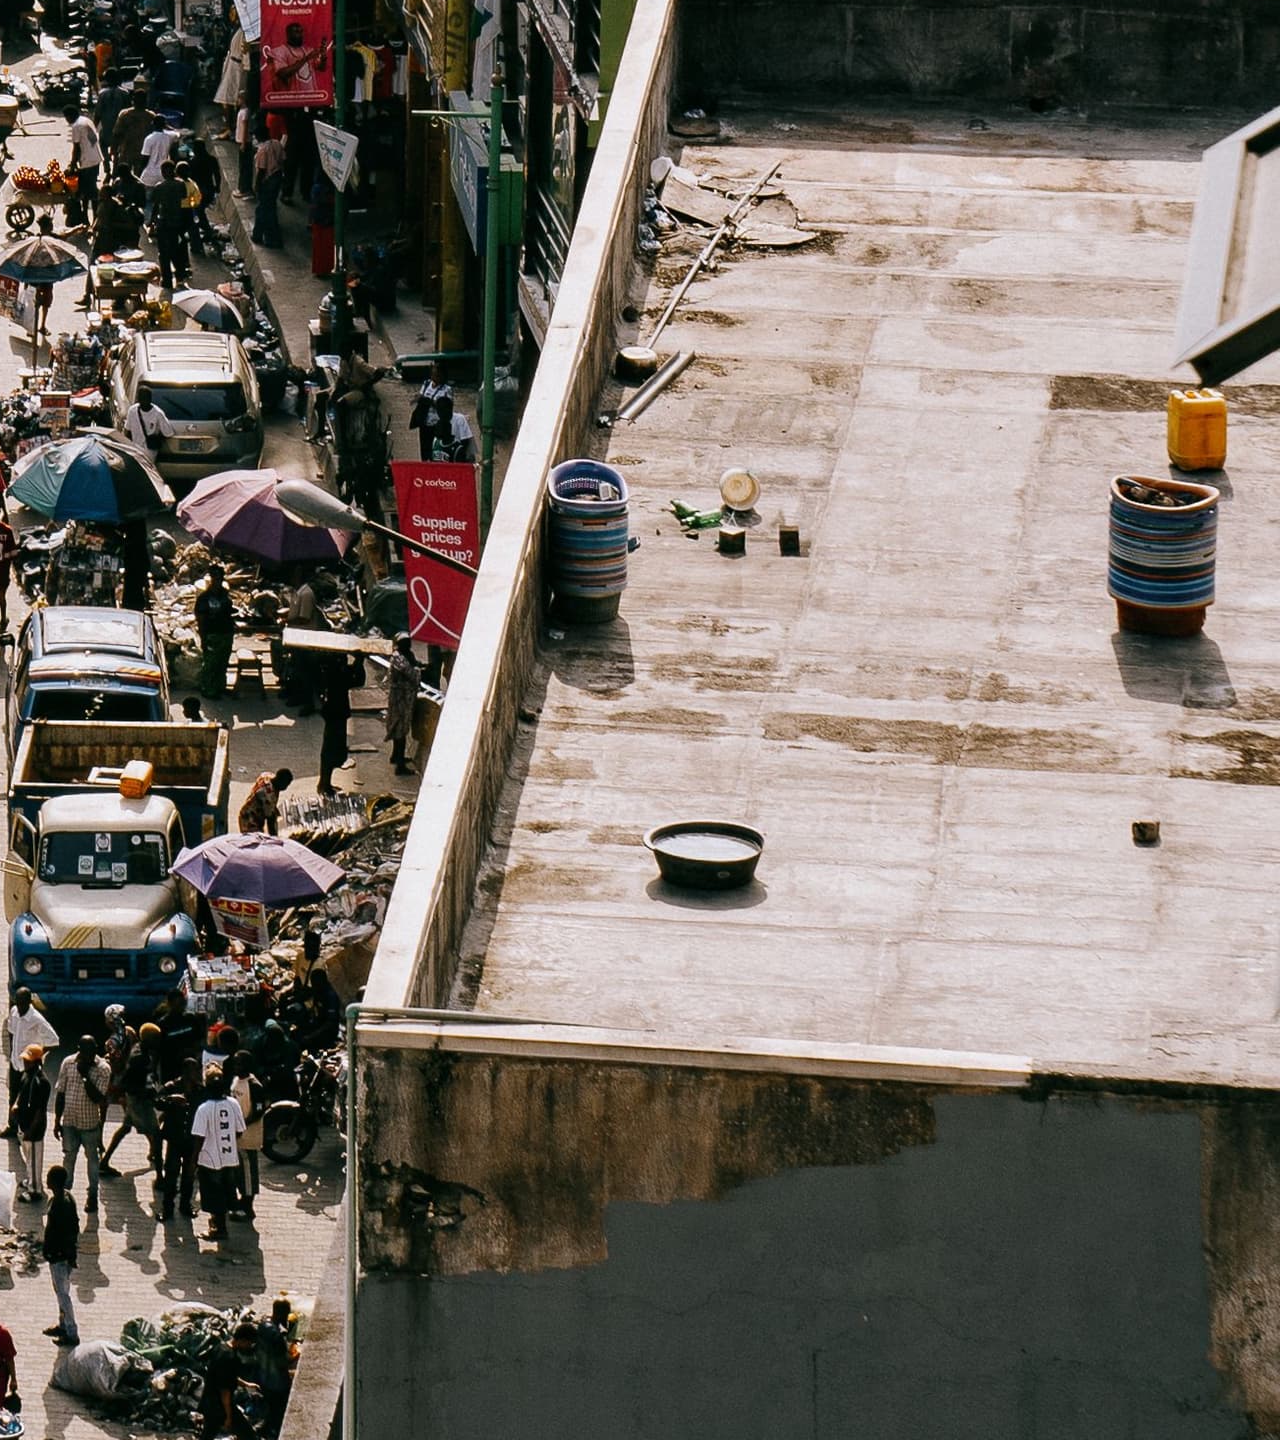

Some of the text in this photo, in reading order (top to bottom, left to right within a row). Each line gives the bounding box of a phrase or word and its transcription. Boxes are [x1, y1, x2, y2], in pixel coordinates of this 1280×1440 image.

[425, 478, 457, 487] carbon
[412, 514, 468, 531] Supplier
[421, 531, 462, 545] prices
[219, 1109, 232, 1154] CRTZ
